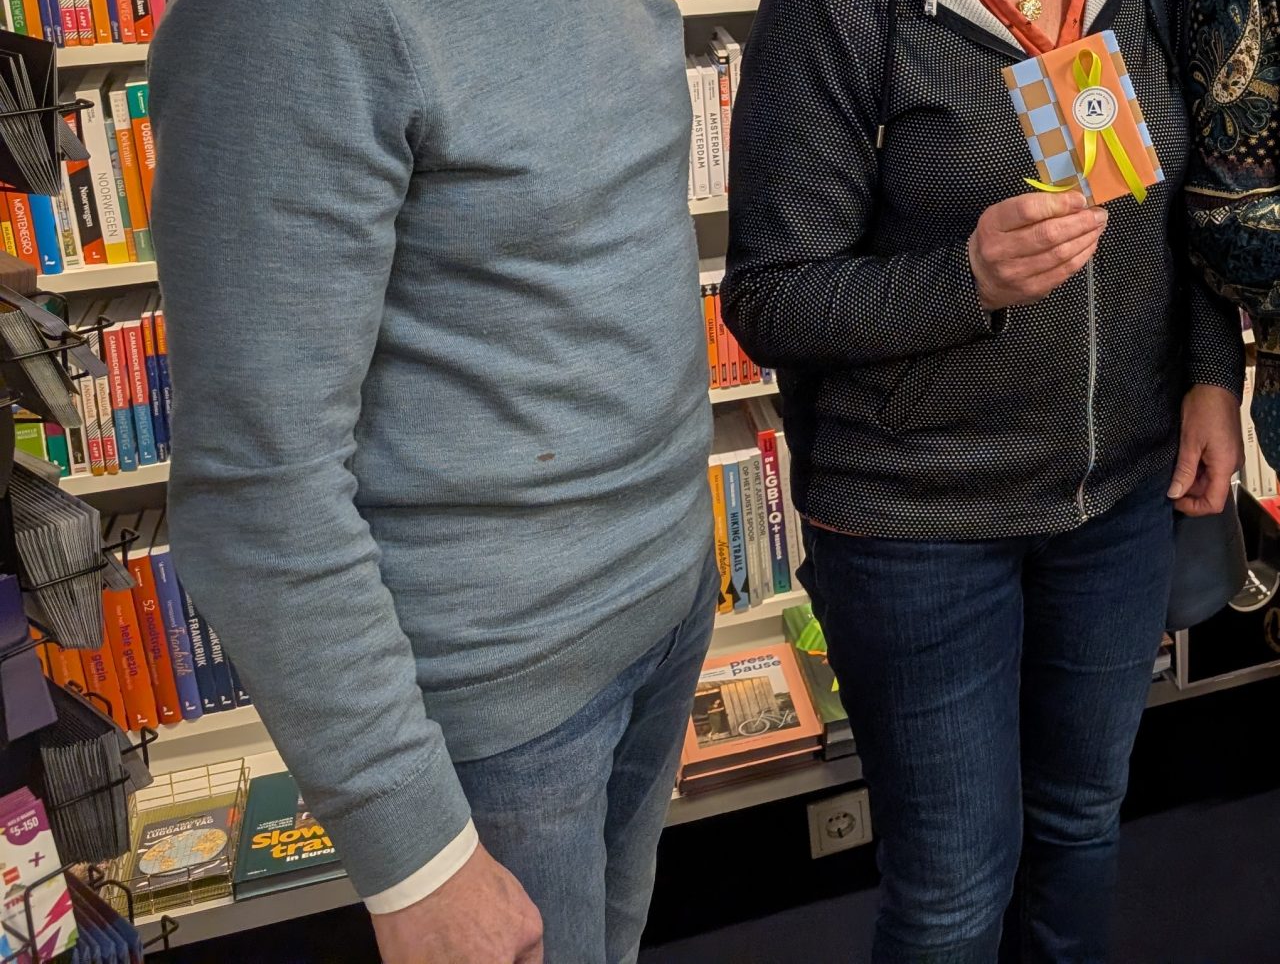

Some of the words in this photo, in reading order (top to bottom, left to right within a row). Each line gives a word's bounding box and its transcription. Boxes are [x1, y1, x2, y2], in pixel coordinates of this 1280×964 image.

[141, 122, 156, 170] Oostenrijk
[695, 114, 704, 169] AMSTERDAM
[710, 112, 719, 166] AMSTERDAM
[80, 186, 93, 227] Noorwegen
[97, 172, 118, 237] NOORWEGEN
[14, 198, 33, 255] MONTENEGRO
[109, 335, 120, 374] CANARISCHE
[129, 331, 140, 371] CANARISCHE
[114, 376, 123, 407] EILANDEN
[134, 372, 143, 403] EILANDEN
[754, 461, 760, 471] OP
[765, 464, 781, 533] LGBTQ+
[730, 512, 740, 541] HIKING
[732, 543, 742, 572] TRAILS
[189, 618, 207, 667] FRANKRIJK
[730, 653, 774, 669] press
[124, 648, 138, 677] gezin
[732, 660, 781, 676] pause
[252, 826, 325, 850] Slow
